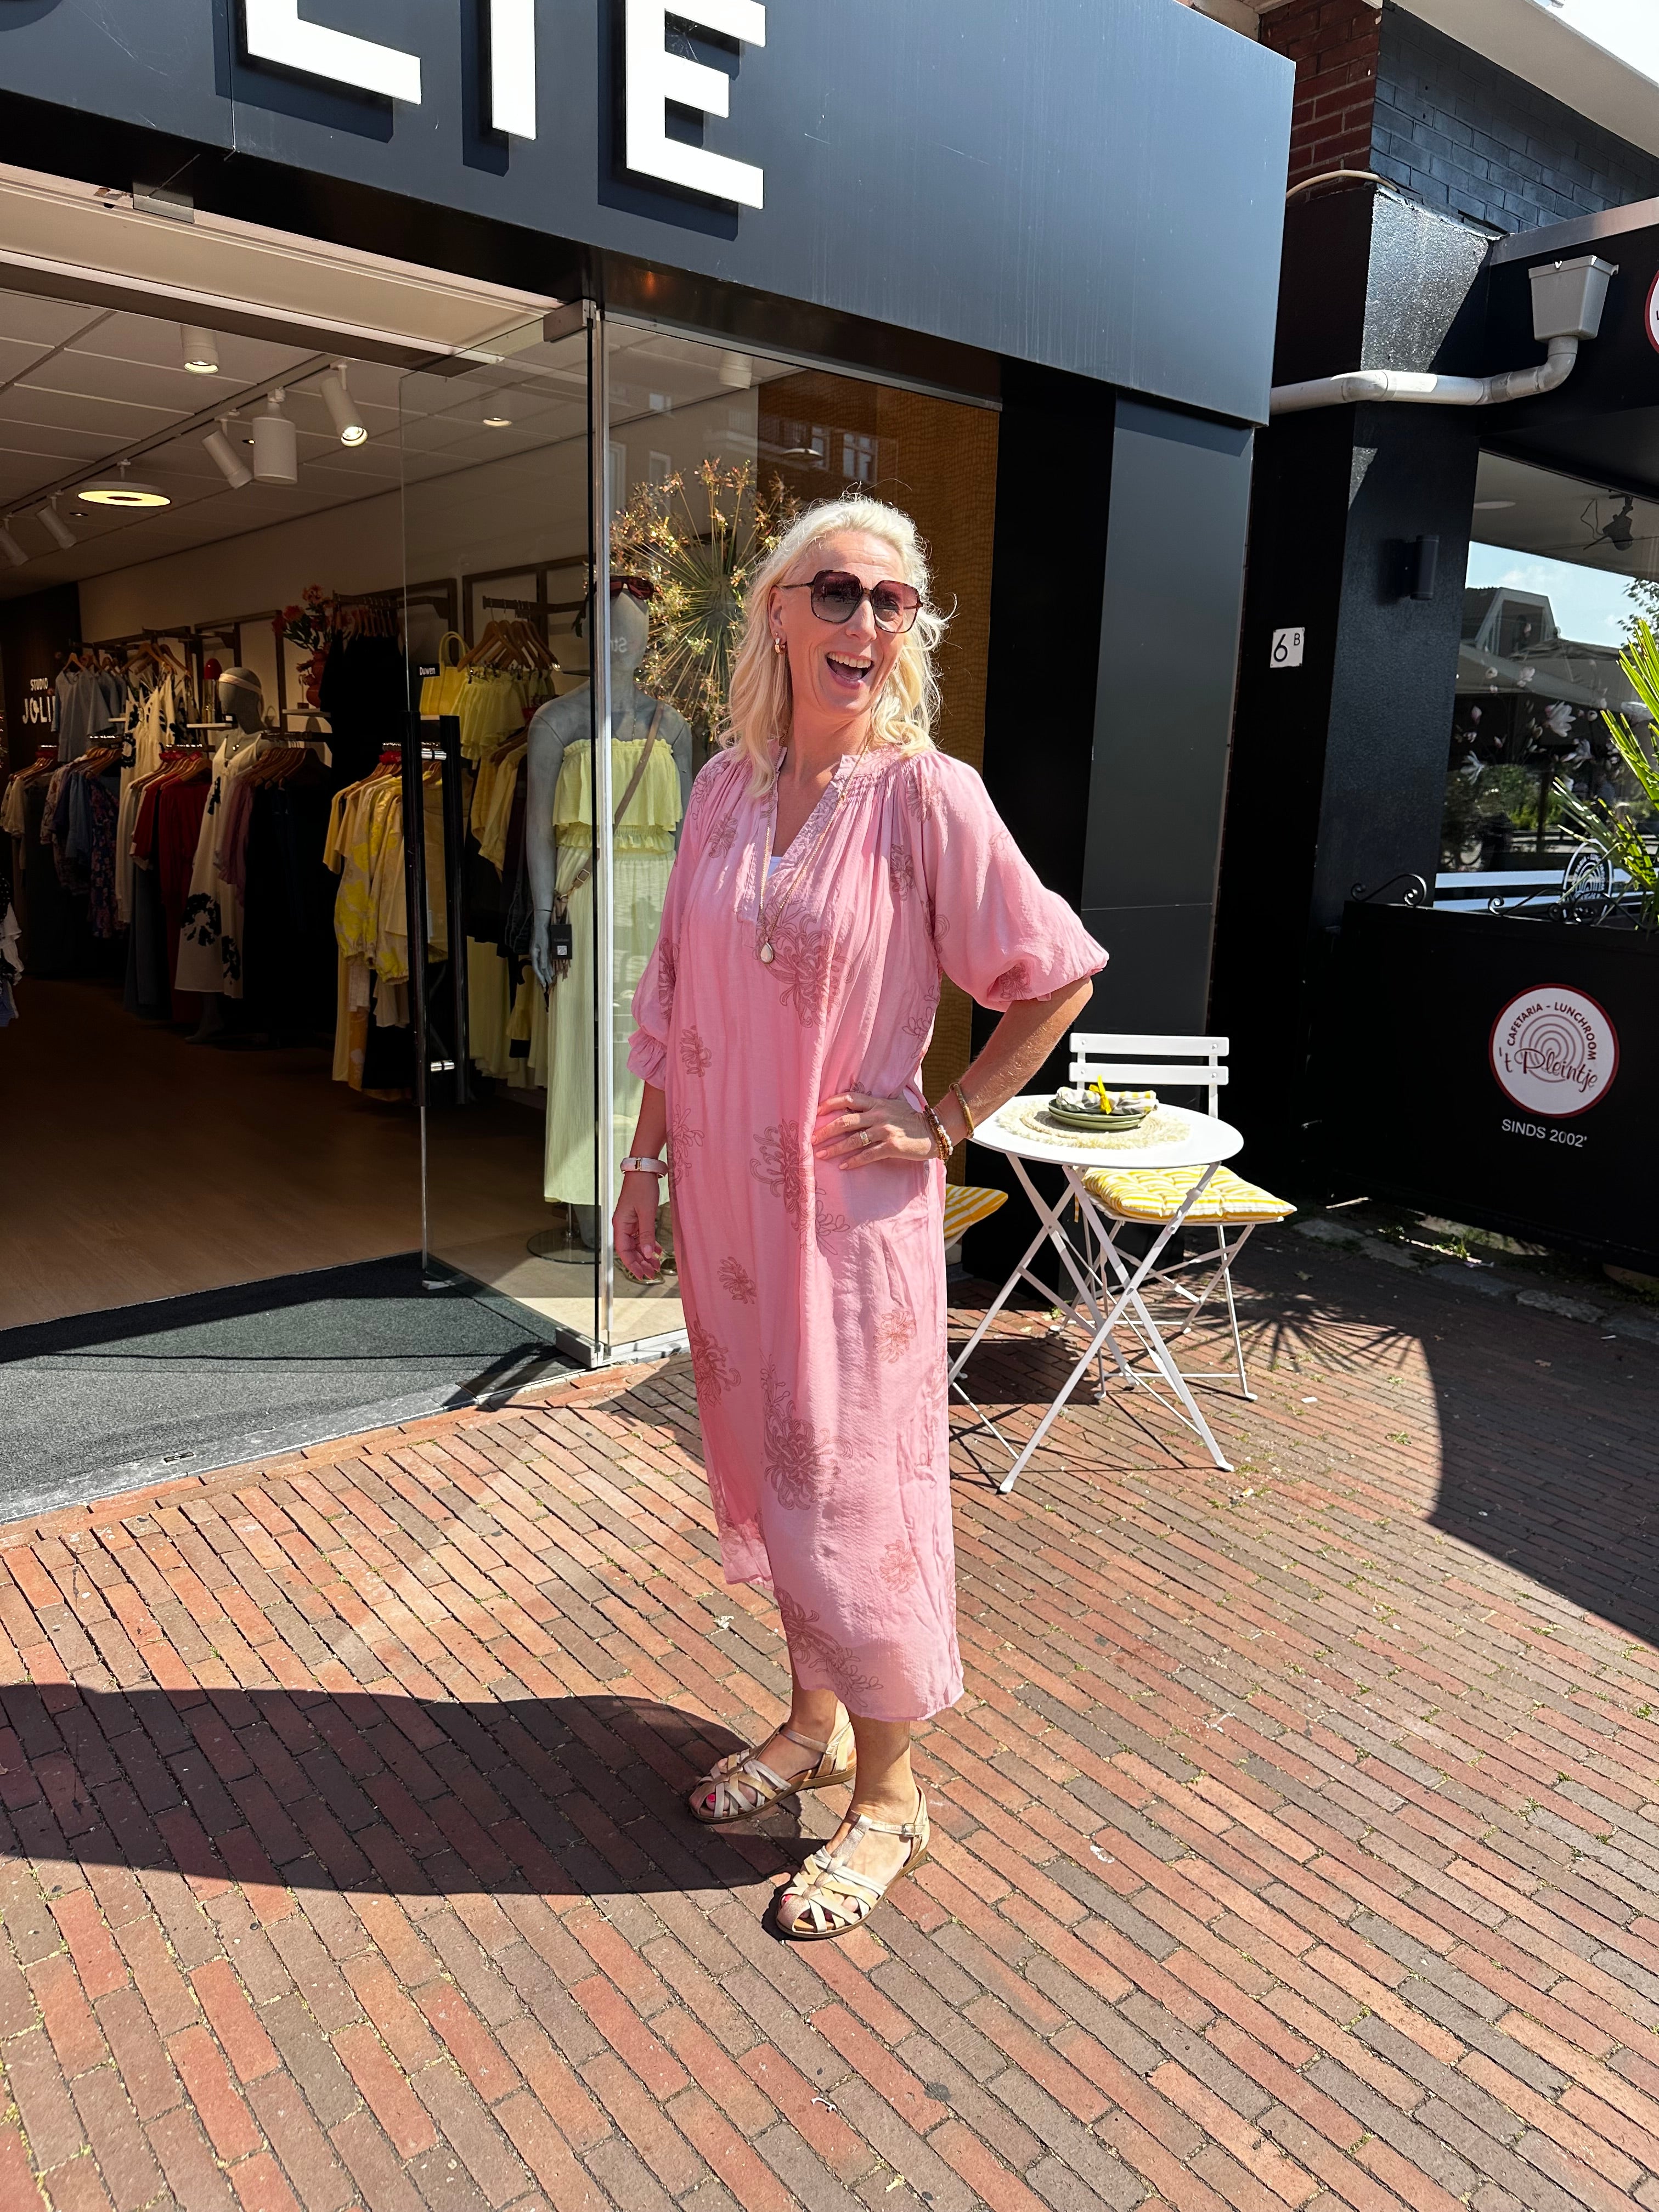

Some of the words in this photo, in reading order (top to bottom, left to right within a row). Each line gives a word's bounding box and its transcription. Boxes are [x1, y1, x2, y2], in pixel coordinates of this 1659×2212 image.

[22, 696, 55, 724] JOLI
[1507, 1003, 1543, 1046] CAFETARIA
[1554, 1002, 1597, 1060] LUNCHROOM
[1514, 1048, 1598, 1092] Pleintje
[1502, 1119, 1546, 1139] SINDS
